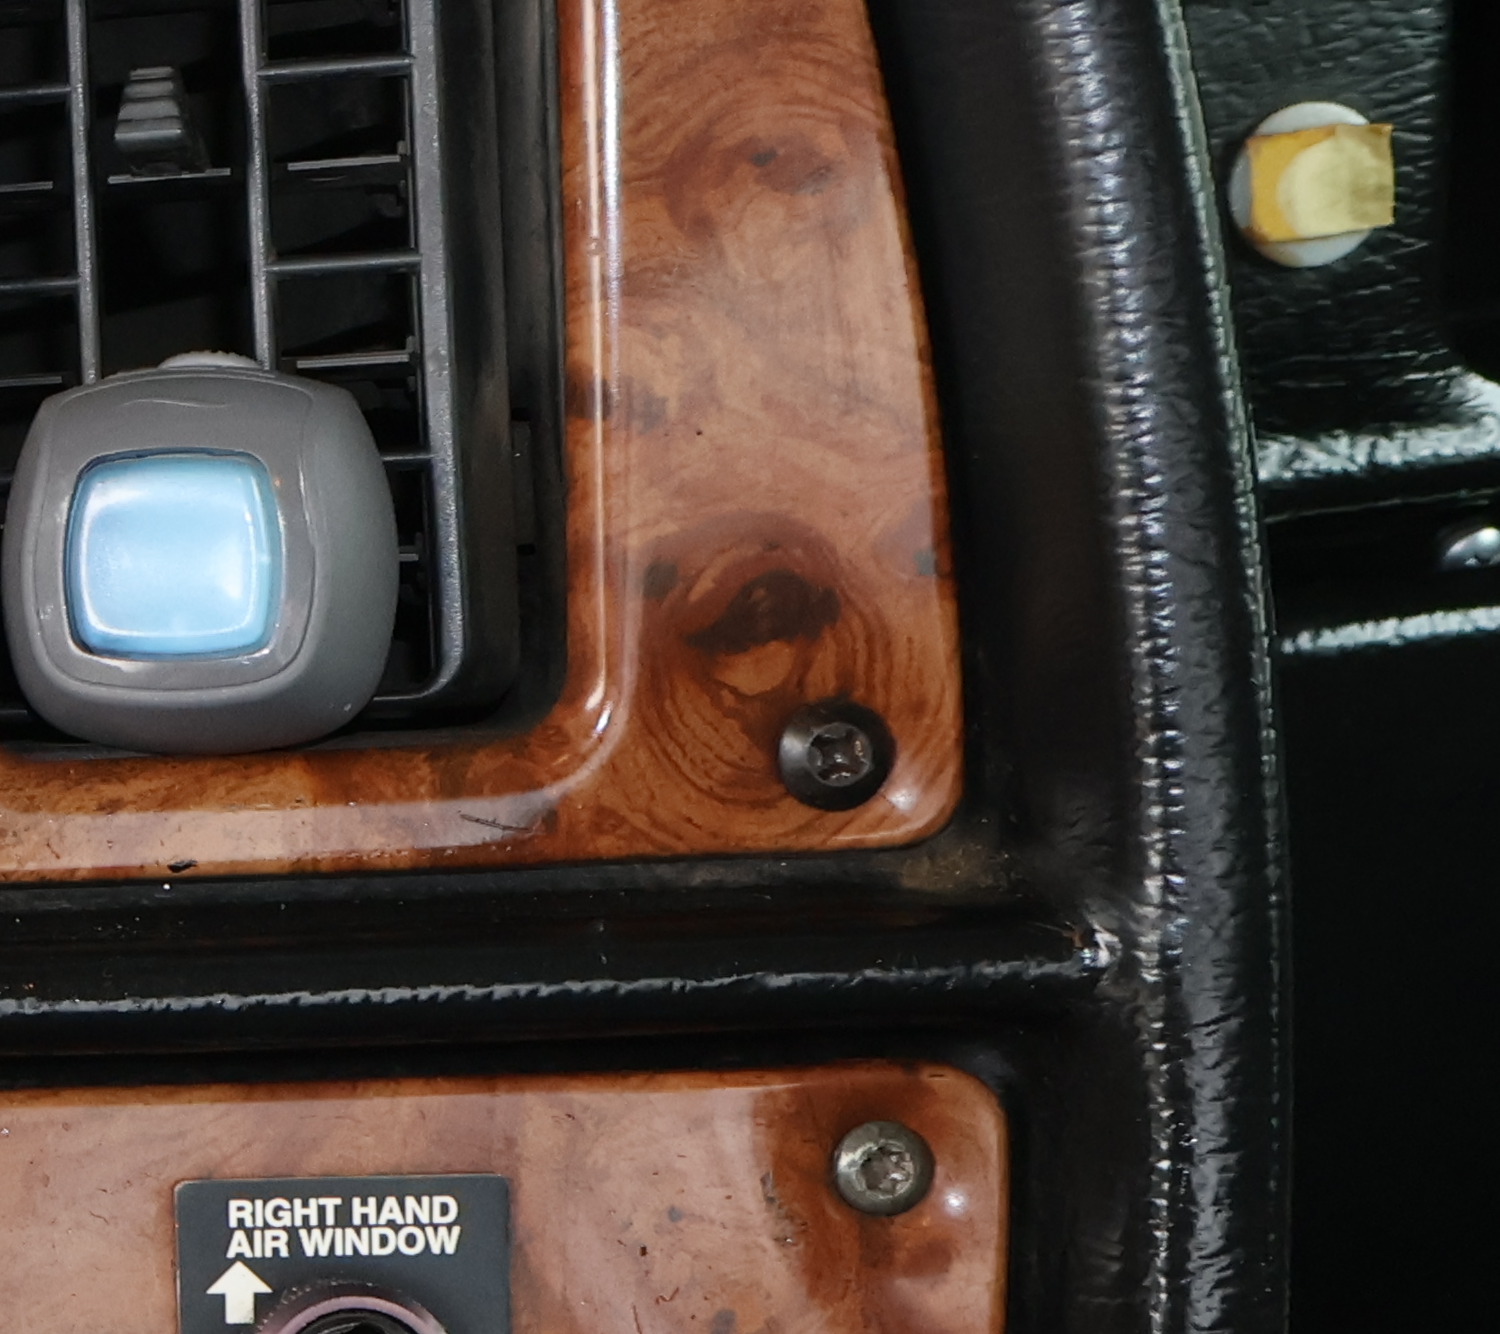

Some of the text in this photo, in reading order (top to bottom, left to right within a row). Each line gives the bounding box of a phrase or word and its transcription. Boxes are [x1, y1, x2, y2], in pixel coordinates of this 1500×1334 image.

[228, 1195, 459, 1228] RIGHT HAND
[226, 1225, 461, 1258] AIR WINDOW
